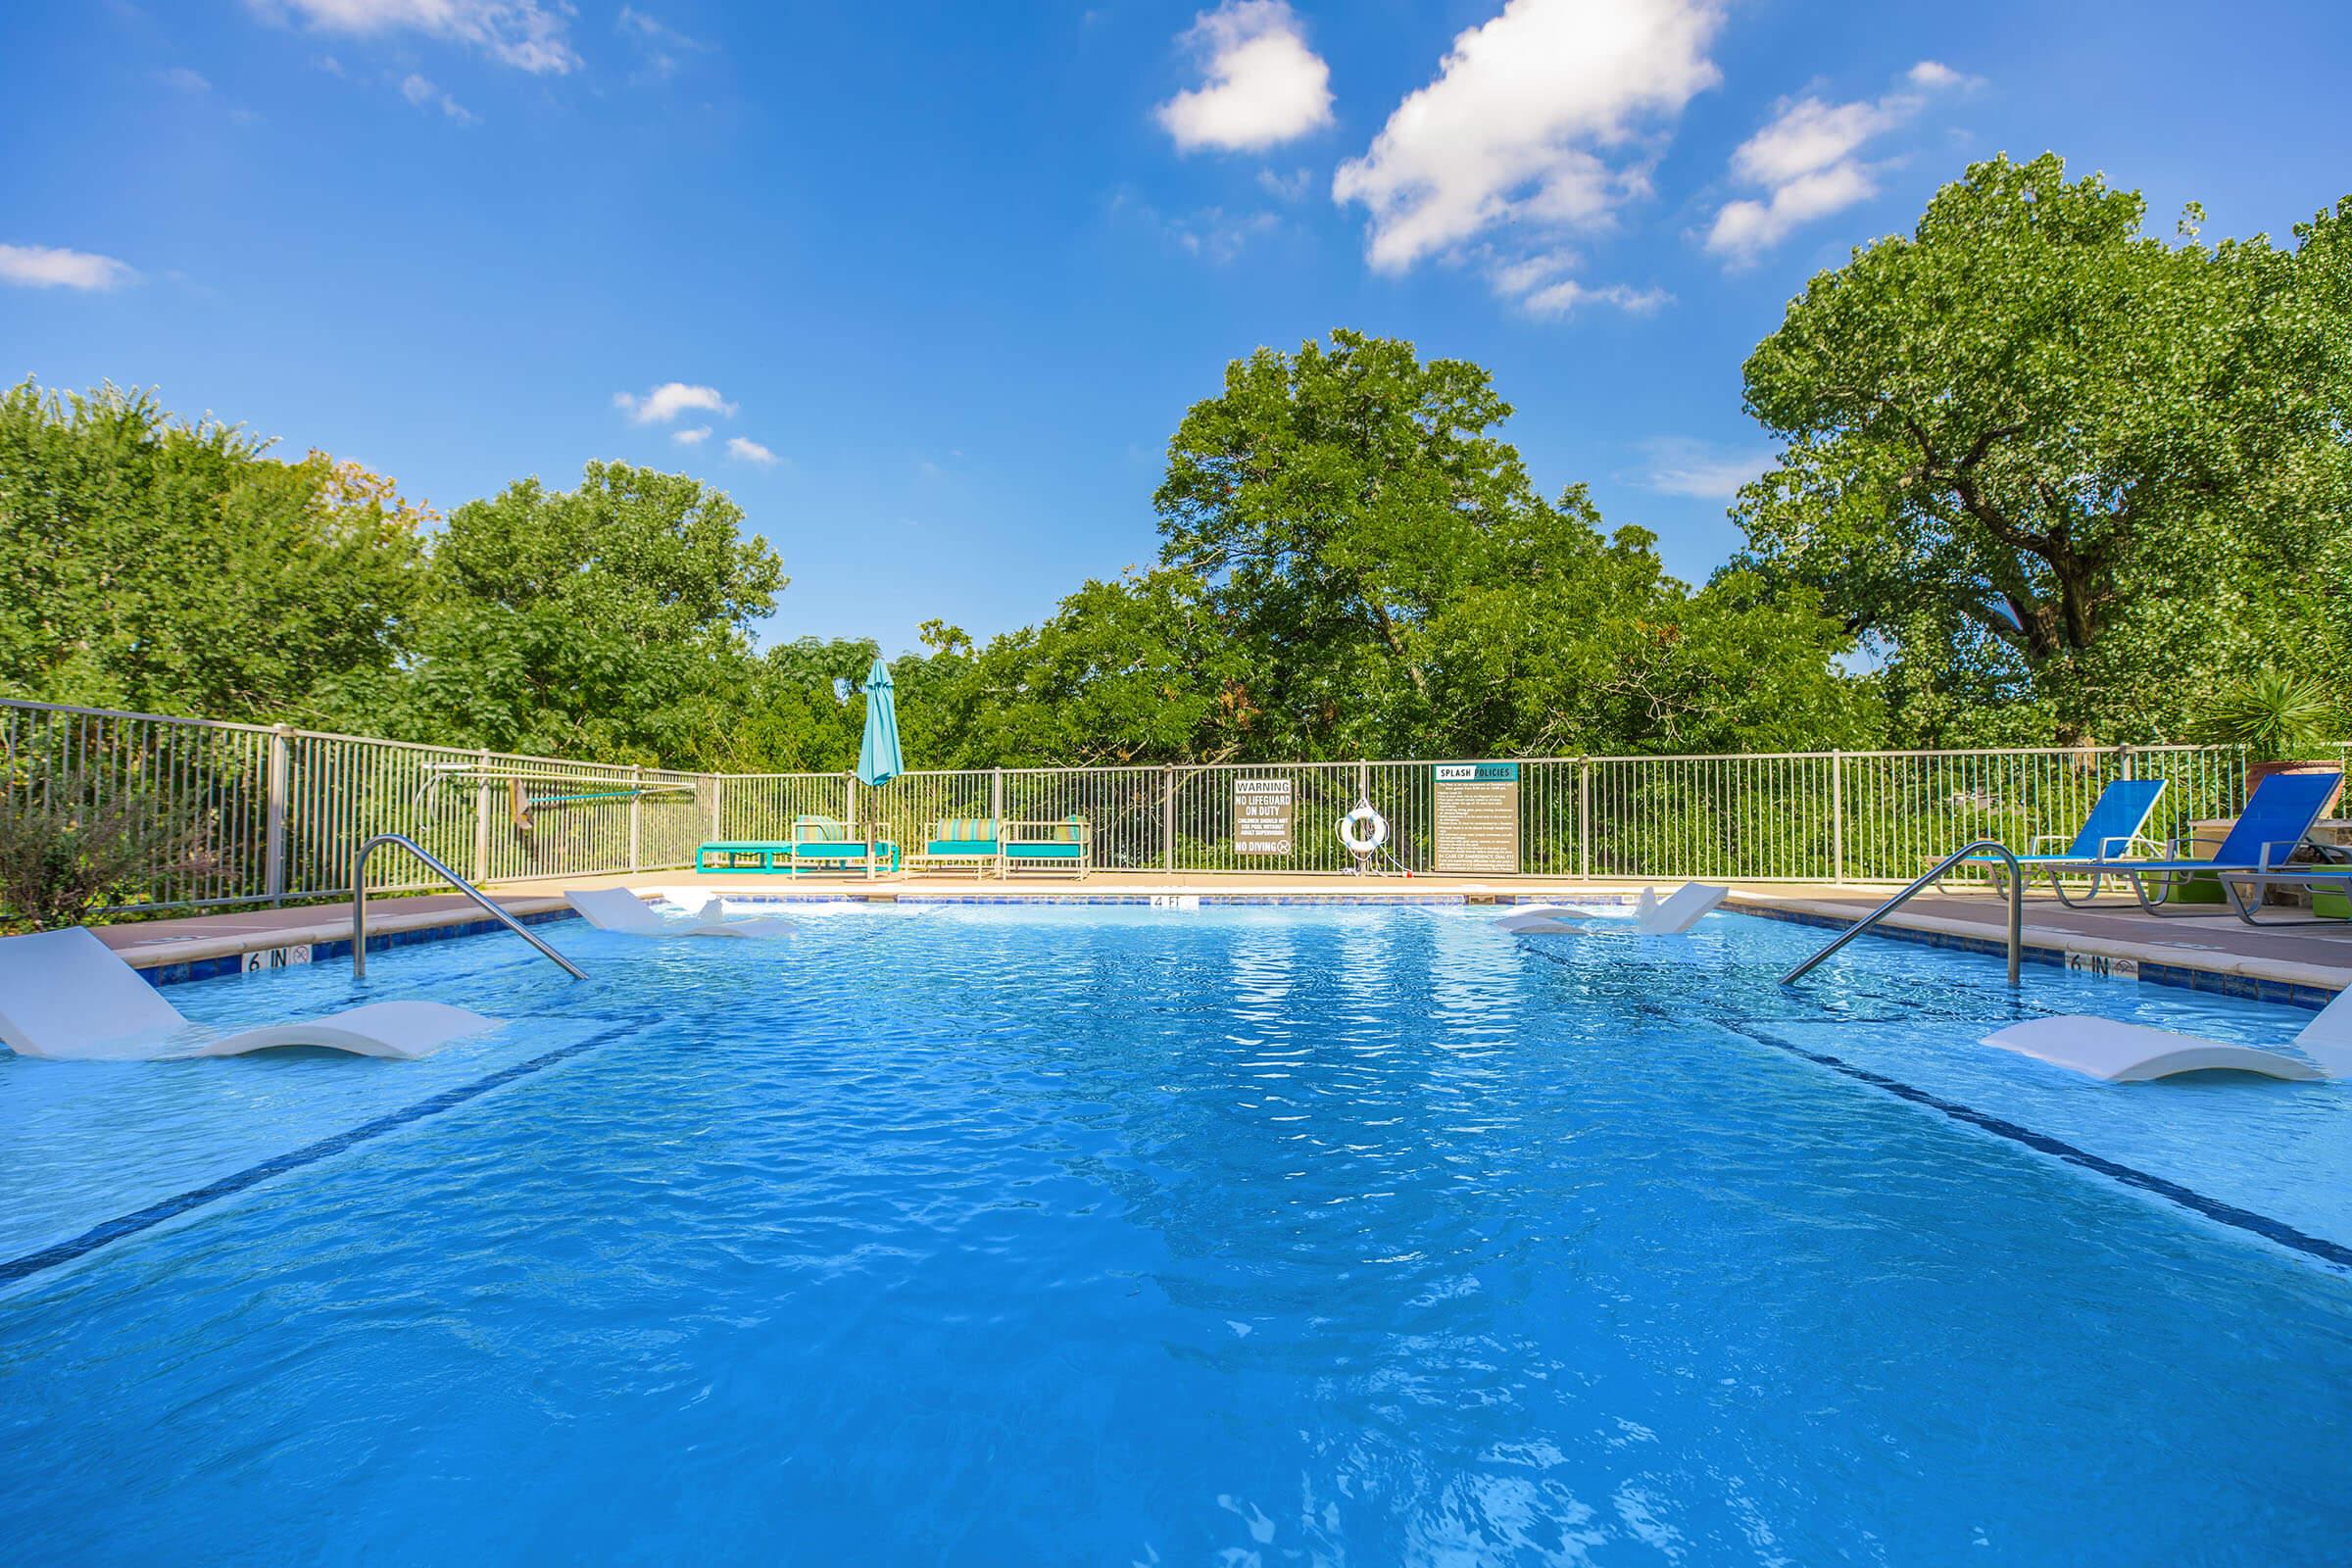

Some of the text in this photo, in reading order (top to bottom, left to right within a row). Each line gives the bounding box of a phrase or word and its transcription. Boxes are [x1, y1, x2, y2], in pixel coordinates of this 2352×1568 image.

[1441, 767, 1510, 777] SPLASH POLICIES
[1237, 782, 1290, 792] WARNING
[1236, 795, 1291, 806] NO LIFEGUARD
[1246, 806, 1281, 816] ON DUTY
[1236, 842, 1276, 852] NO DIVING
[1154, 896, 1180, 908] 4 FT
[249, 948, 287, 972] 6 IN
[2071, 954, 2109, 976] 6 IN
